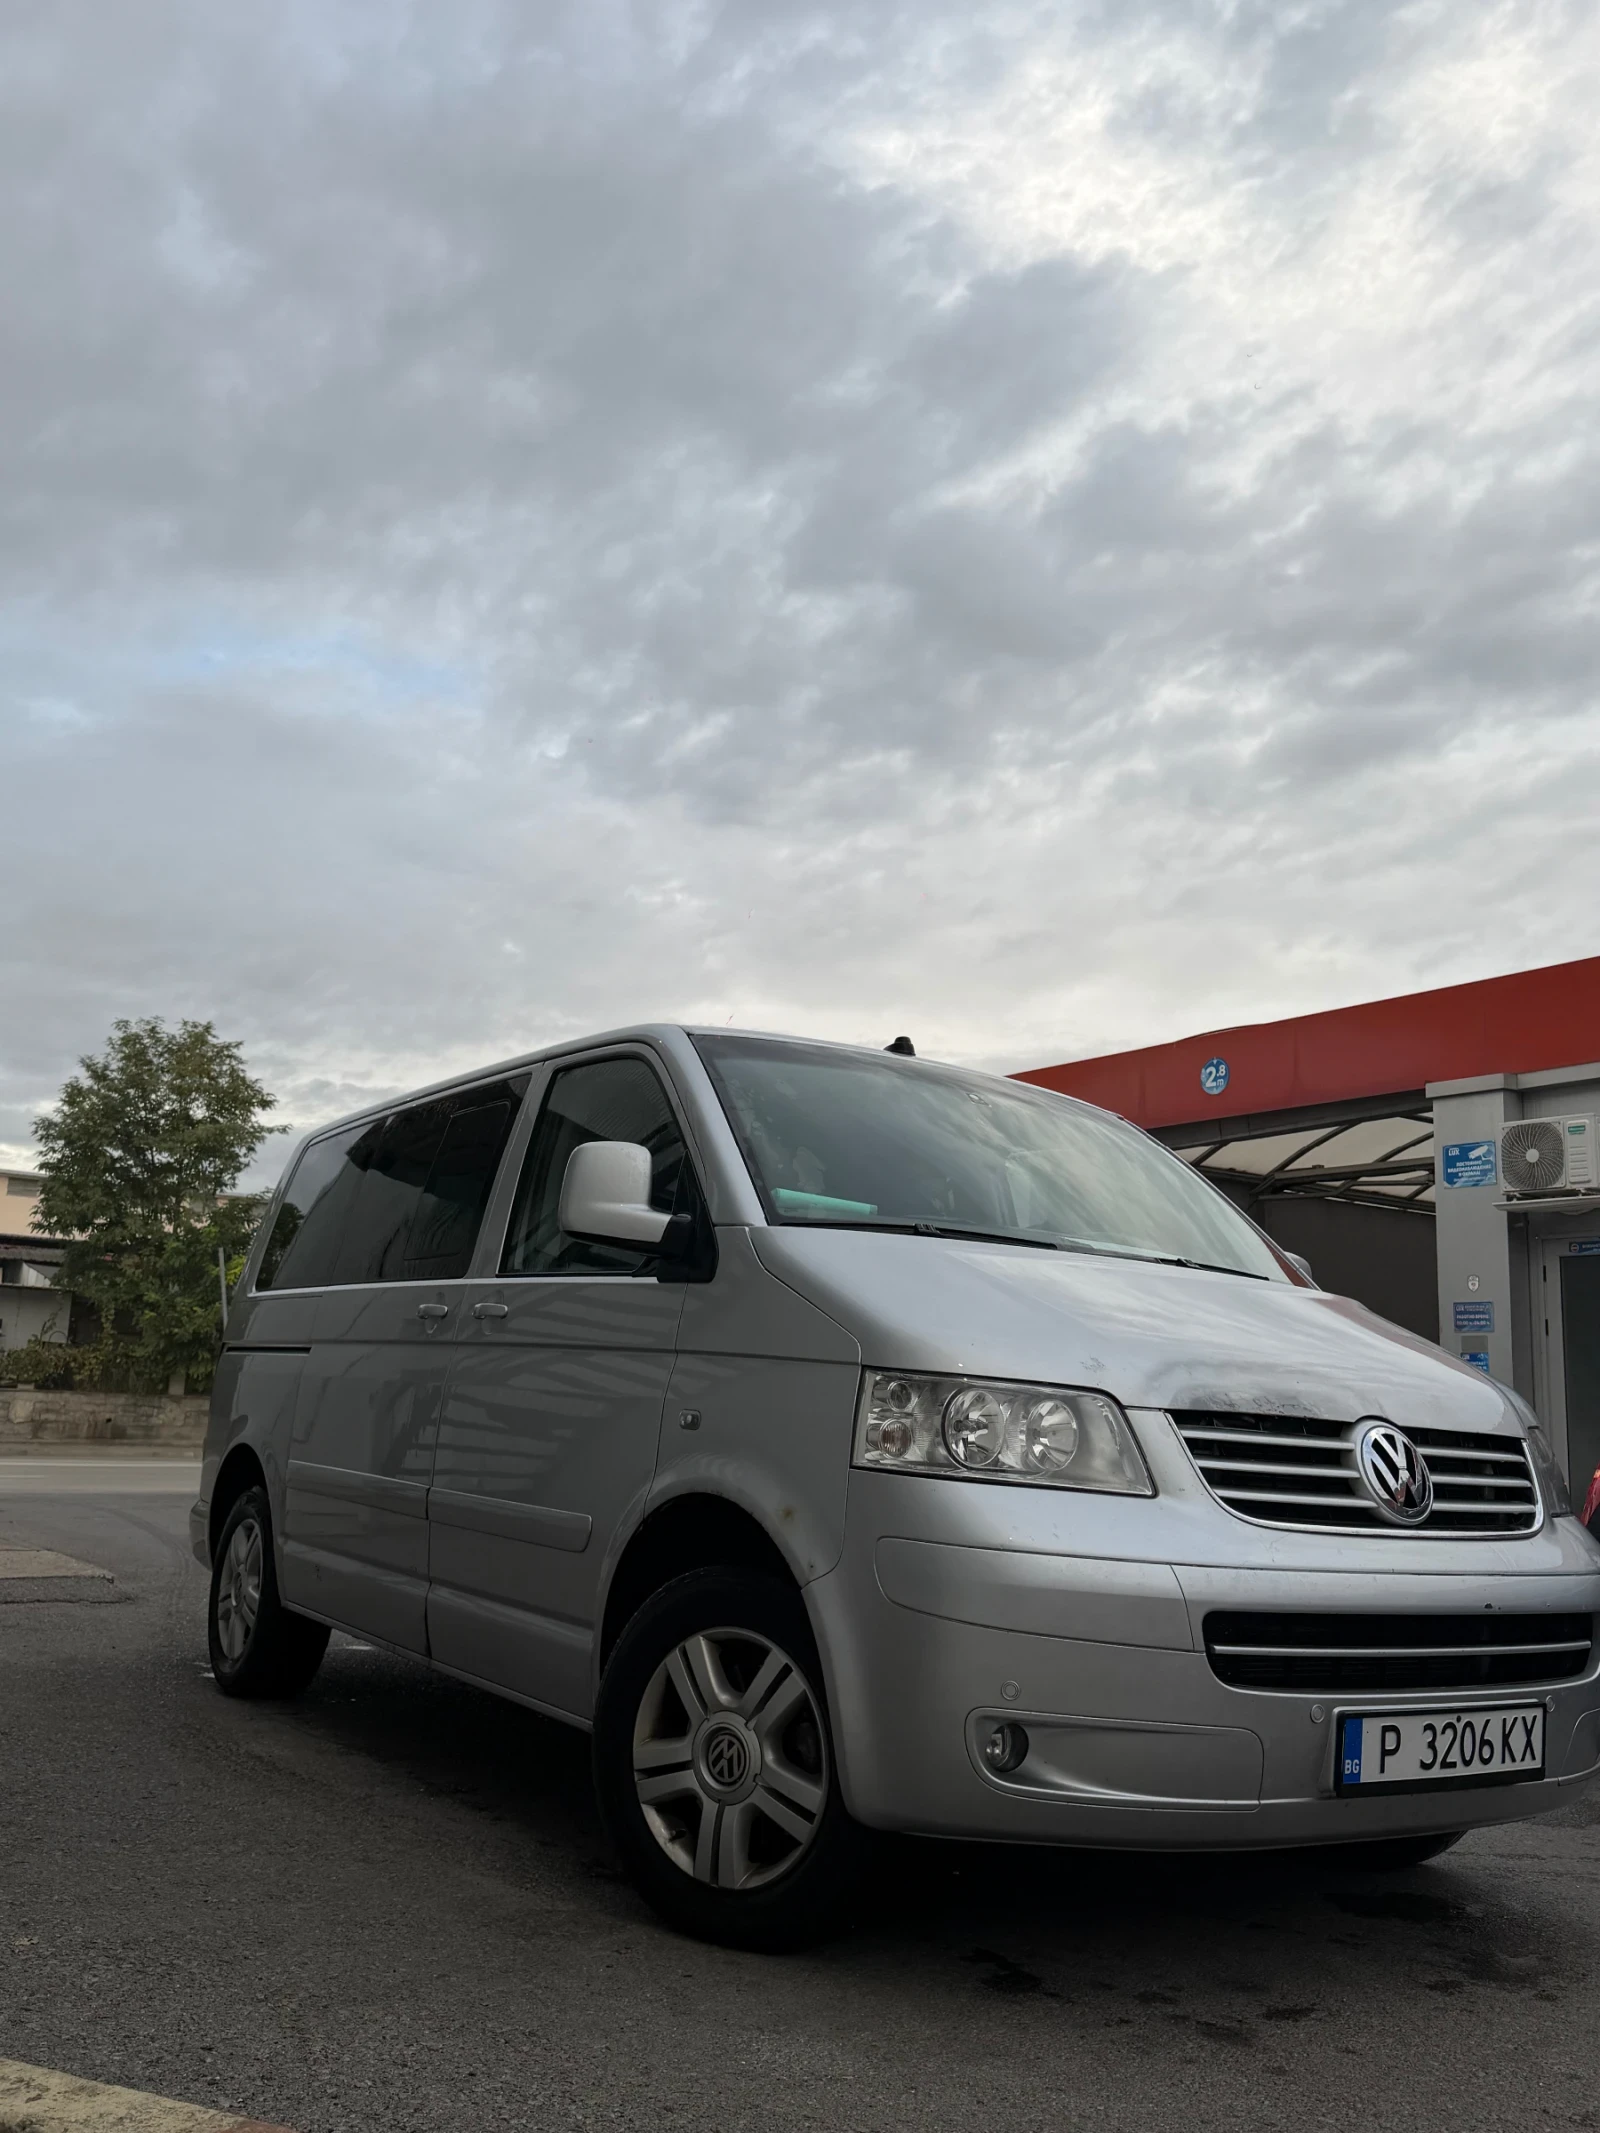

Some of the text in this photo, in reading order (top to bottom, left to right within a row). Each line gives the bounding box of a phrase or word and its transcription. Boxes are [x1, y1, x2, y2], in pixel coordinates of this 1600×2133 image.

[1205, 1064, 1226, 1087] 2.8
[1216, 1079, 1224, 1087] m
[1448, 1148, 1460, 1156] LUX
[1379, 1724, 1401, 1774] P
[1344, 1759, 1360, 1775] BG
